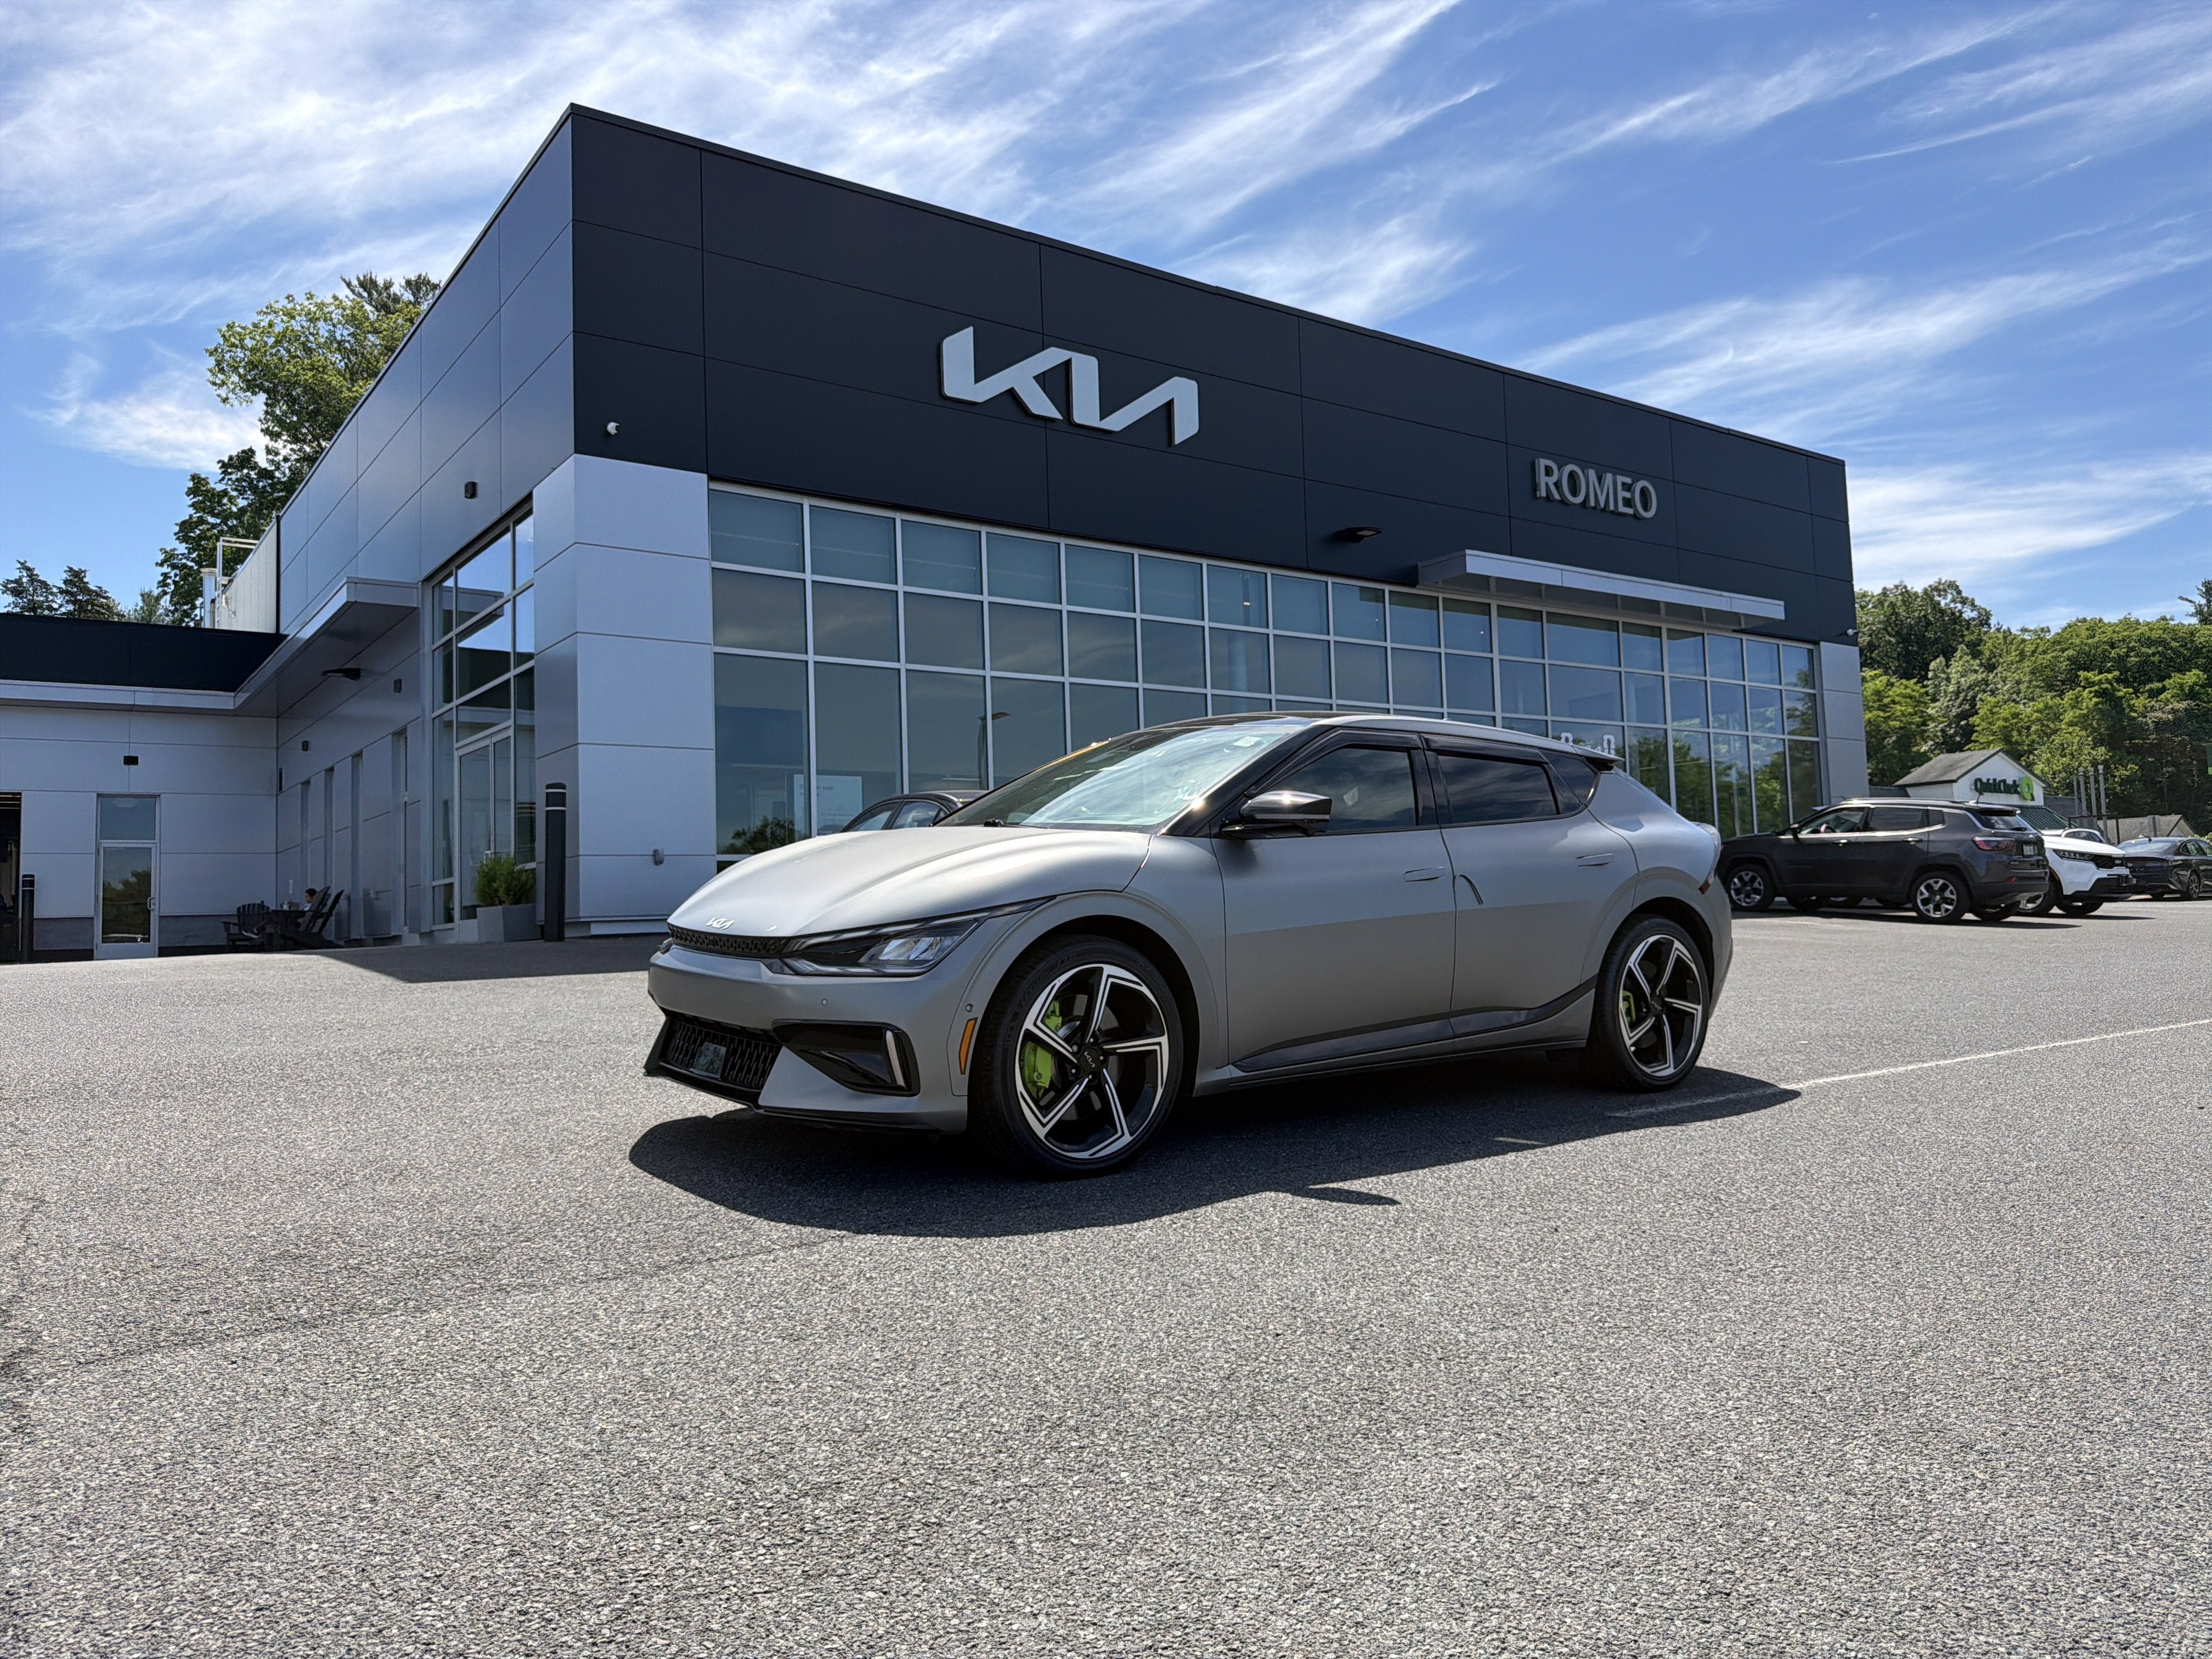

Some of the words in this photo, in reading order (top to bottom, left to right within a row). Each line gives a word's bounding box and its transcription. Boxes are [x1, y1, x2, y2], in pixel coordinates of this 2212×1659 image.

[940, 326, 1199, 445] KIA
[1535, 458, 1657, 520] ROMEO
[706, 917, 736, 930] KIA
